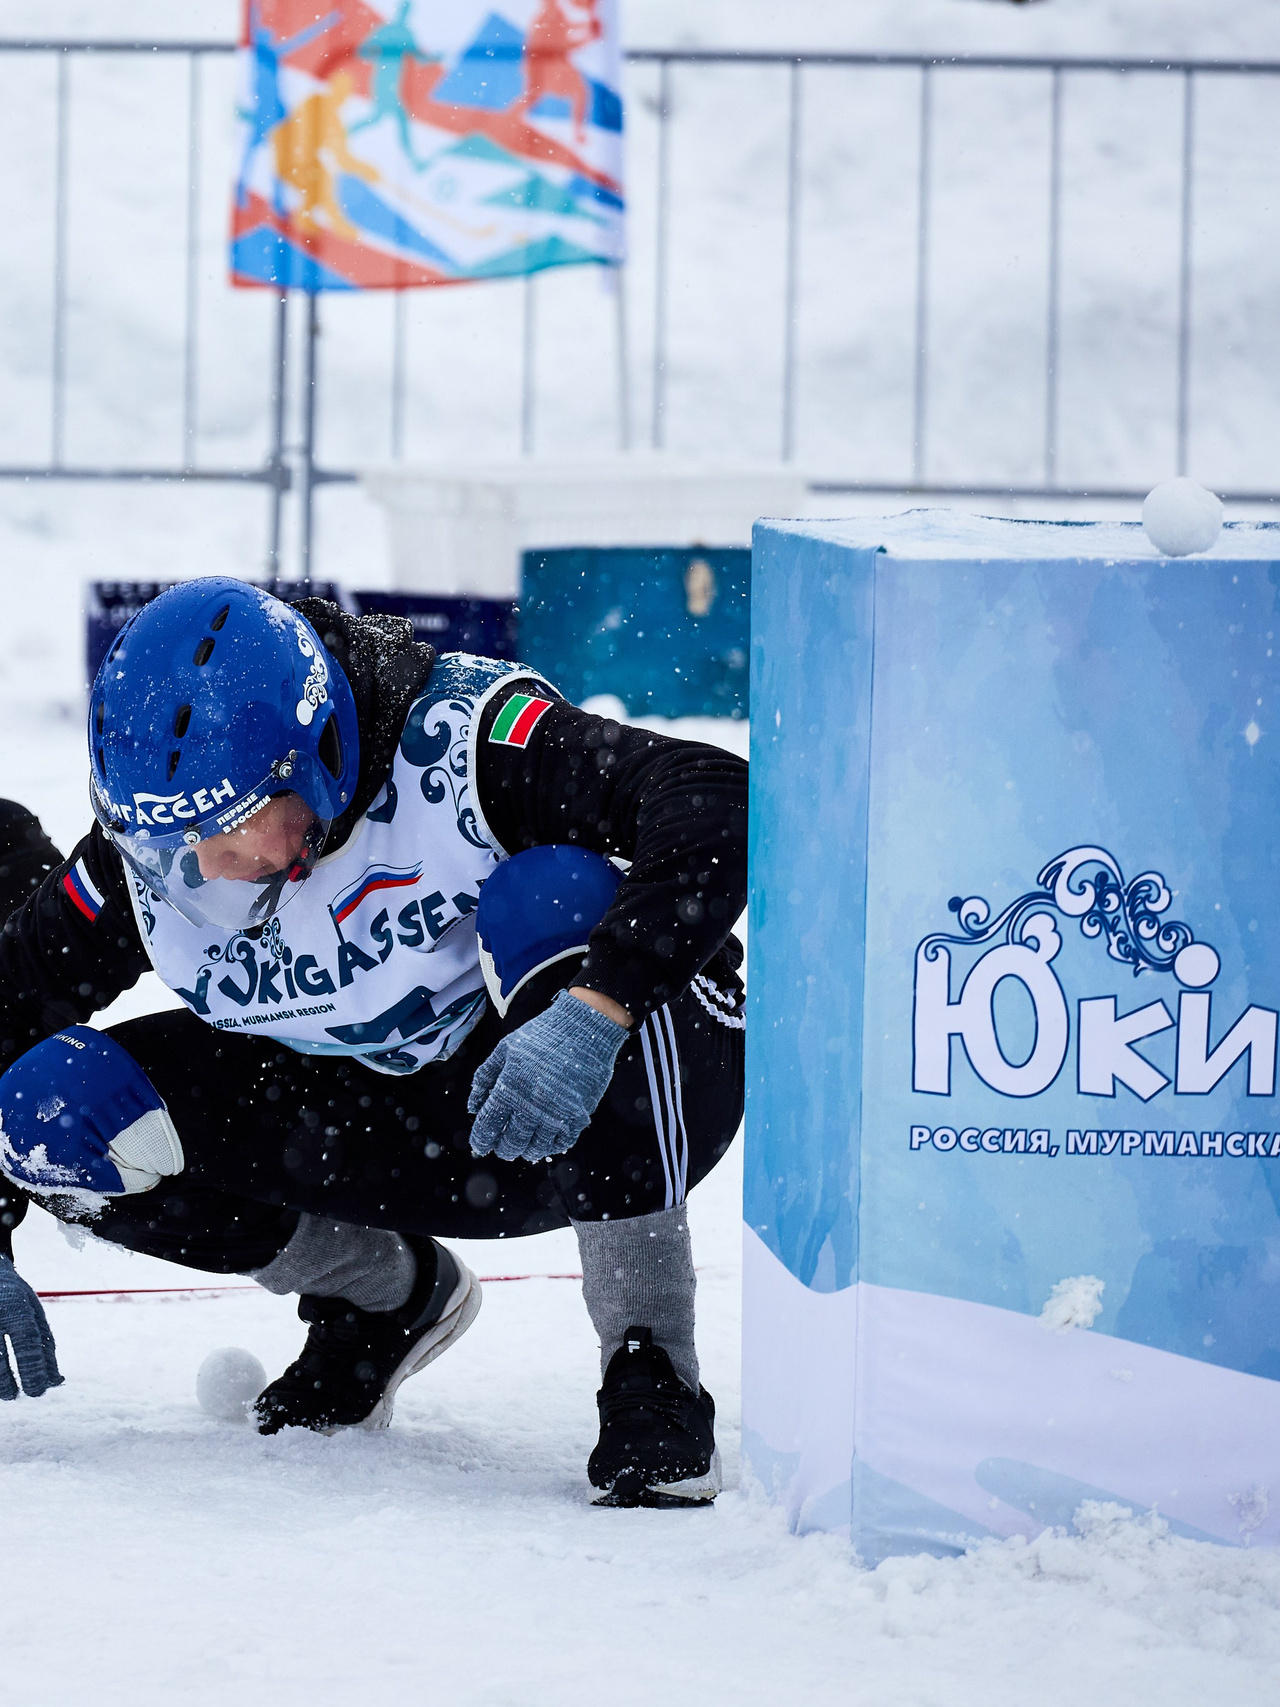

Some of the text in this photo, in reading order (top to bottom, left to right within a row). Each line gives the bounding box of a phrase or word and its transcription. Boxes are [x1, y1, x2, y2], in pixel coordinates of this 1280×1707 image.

[216, 793, 259, 826] ПЕРВЫЕ
[222, 795, 272, 834] В РОССИИ
[208, 1002, 337, 1030] USSIA, MURMANSK REGION
[910, 1125, 1061, 1157] РОССИЯ,
